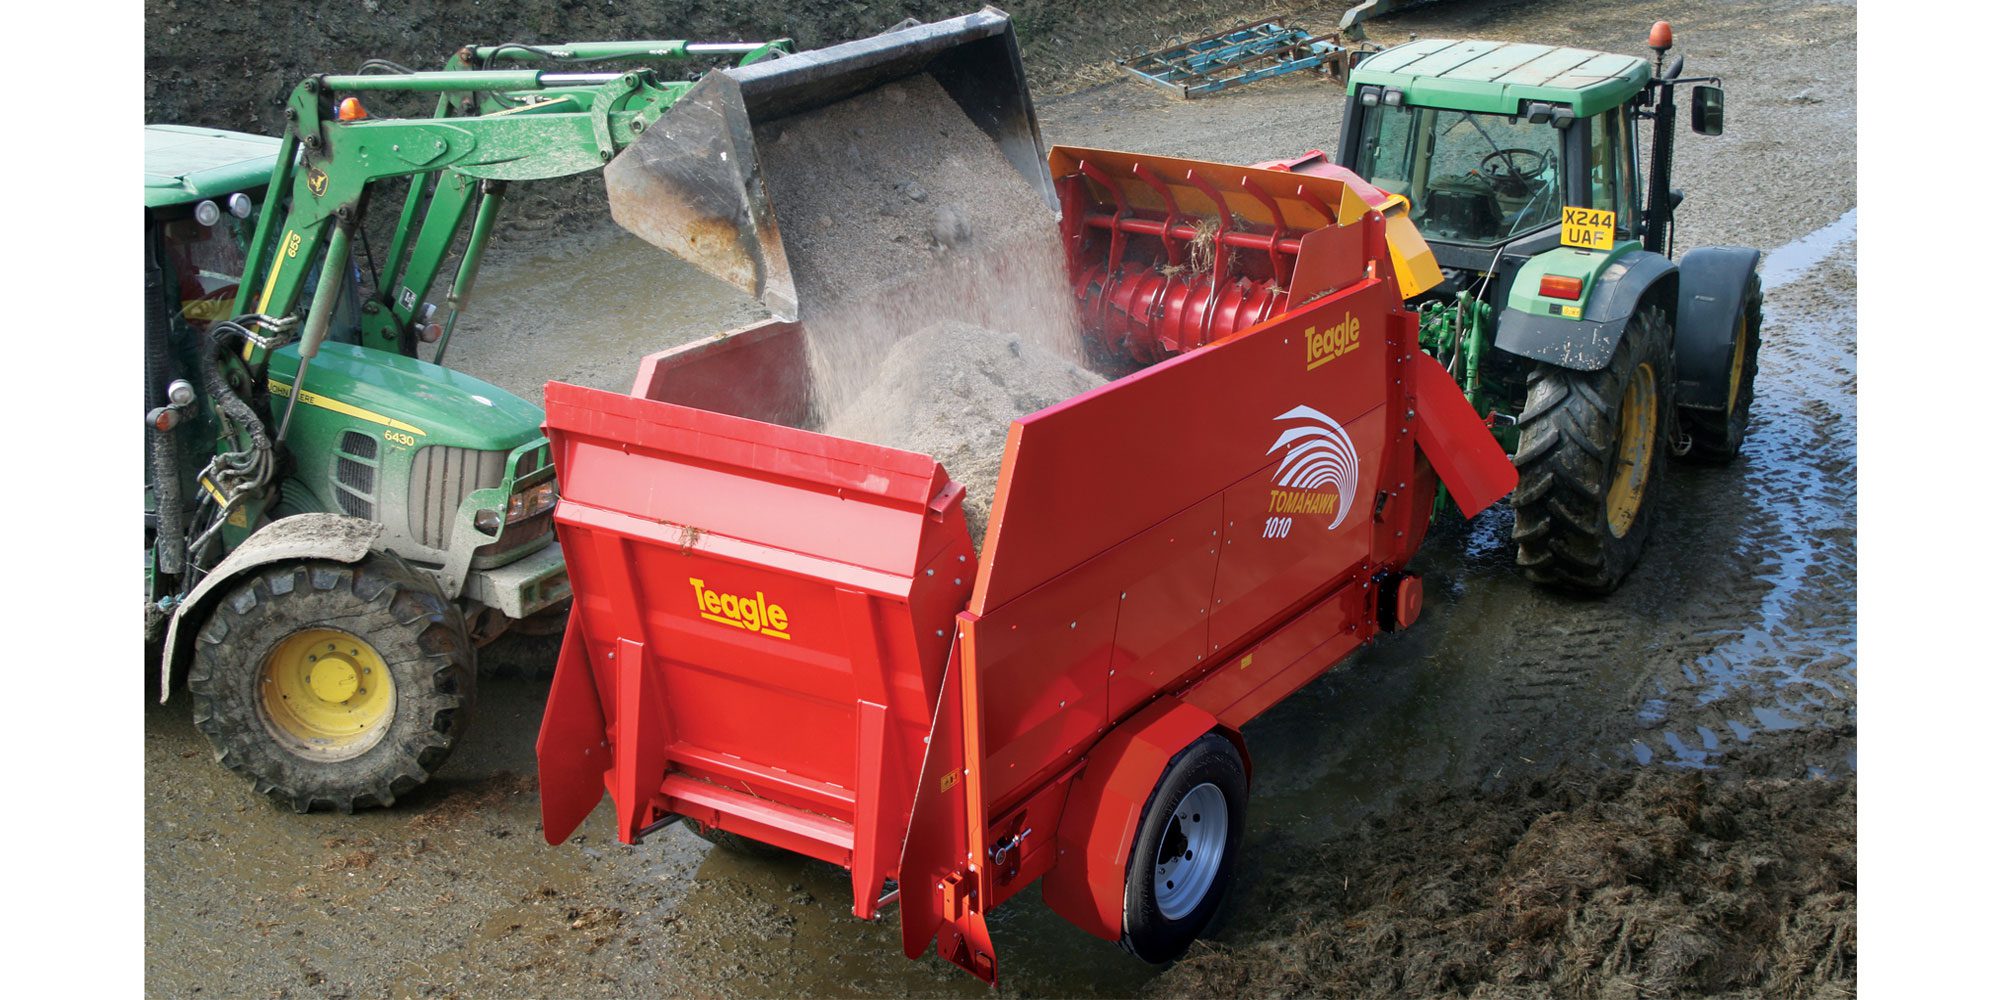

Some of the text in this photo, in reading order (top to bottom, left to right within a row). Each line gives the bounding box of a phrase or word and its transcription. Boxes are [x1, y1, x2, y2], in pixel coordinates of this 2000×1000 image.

[1565, 209, 1612, 229] X244
[288, 233, 302, 258] 653
[1569, 228, 1605, 246] UAF
[1304, 310, 1360, 364] Teagle
[384, 429, 415, 447] 6430
[1268, 489, 1338, 514] TOMAHAWK
[1262, 516, 1292, 539] 1010
[689, 577, 789, 634] Teagle
